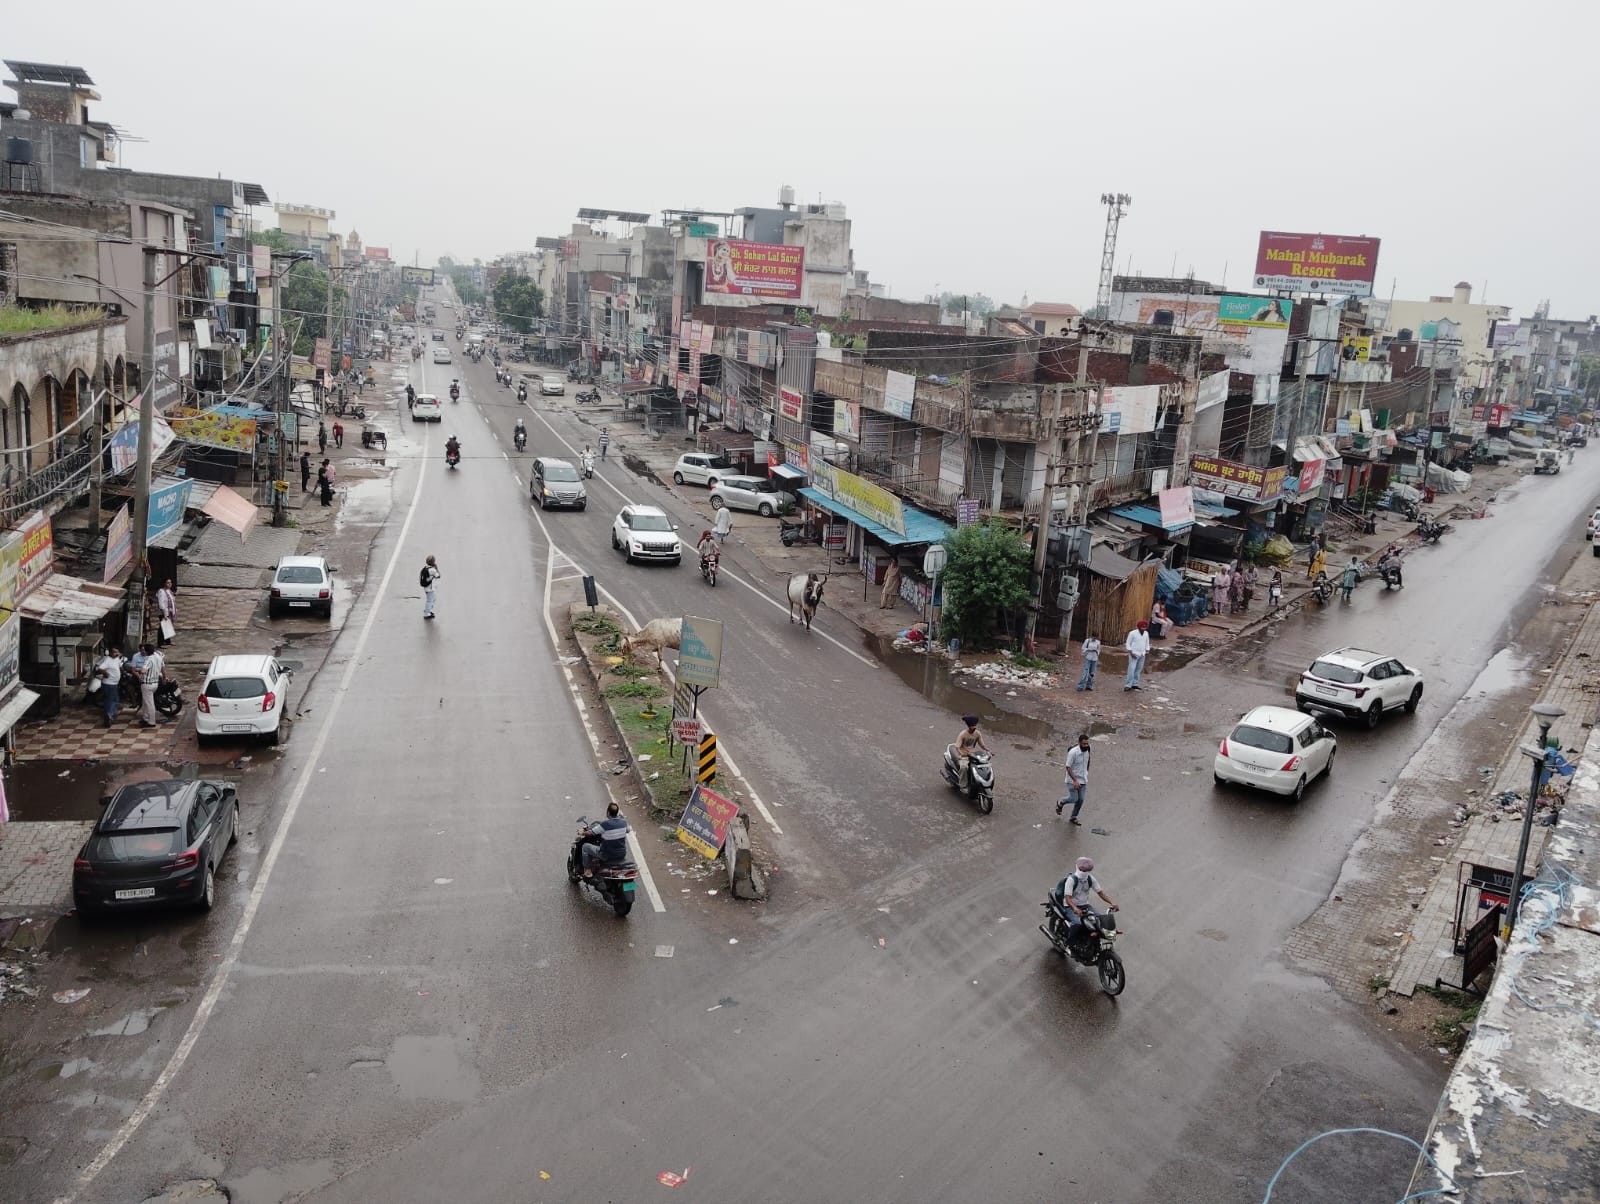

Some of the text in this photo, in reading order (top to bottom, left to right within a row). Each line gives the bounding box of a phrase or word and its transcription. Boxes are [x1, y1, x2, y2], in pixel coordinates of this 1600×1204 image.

[768, 250, 779, 262] Lal
[1266, 248, 1366, 267] Mahal Mubarak
[1291, 263, 1337, 278] Resort
